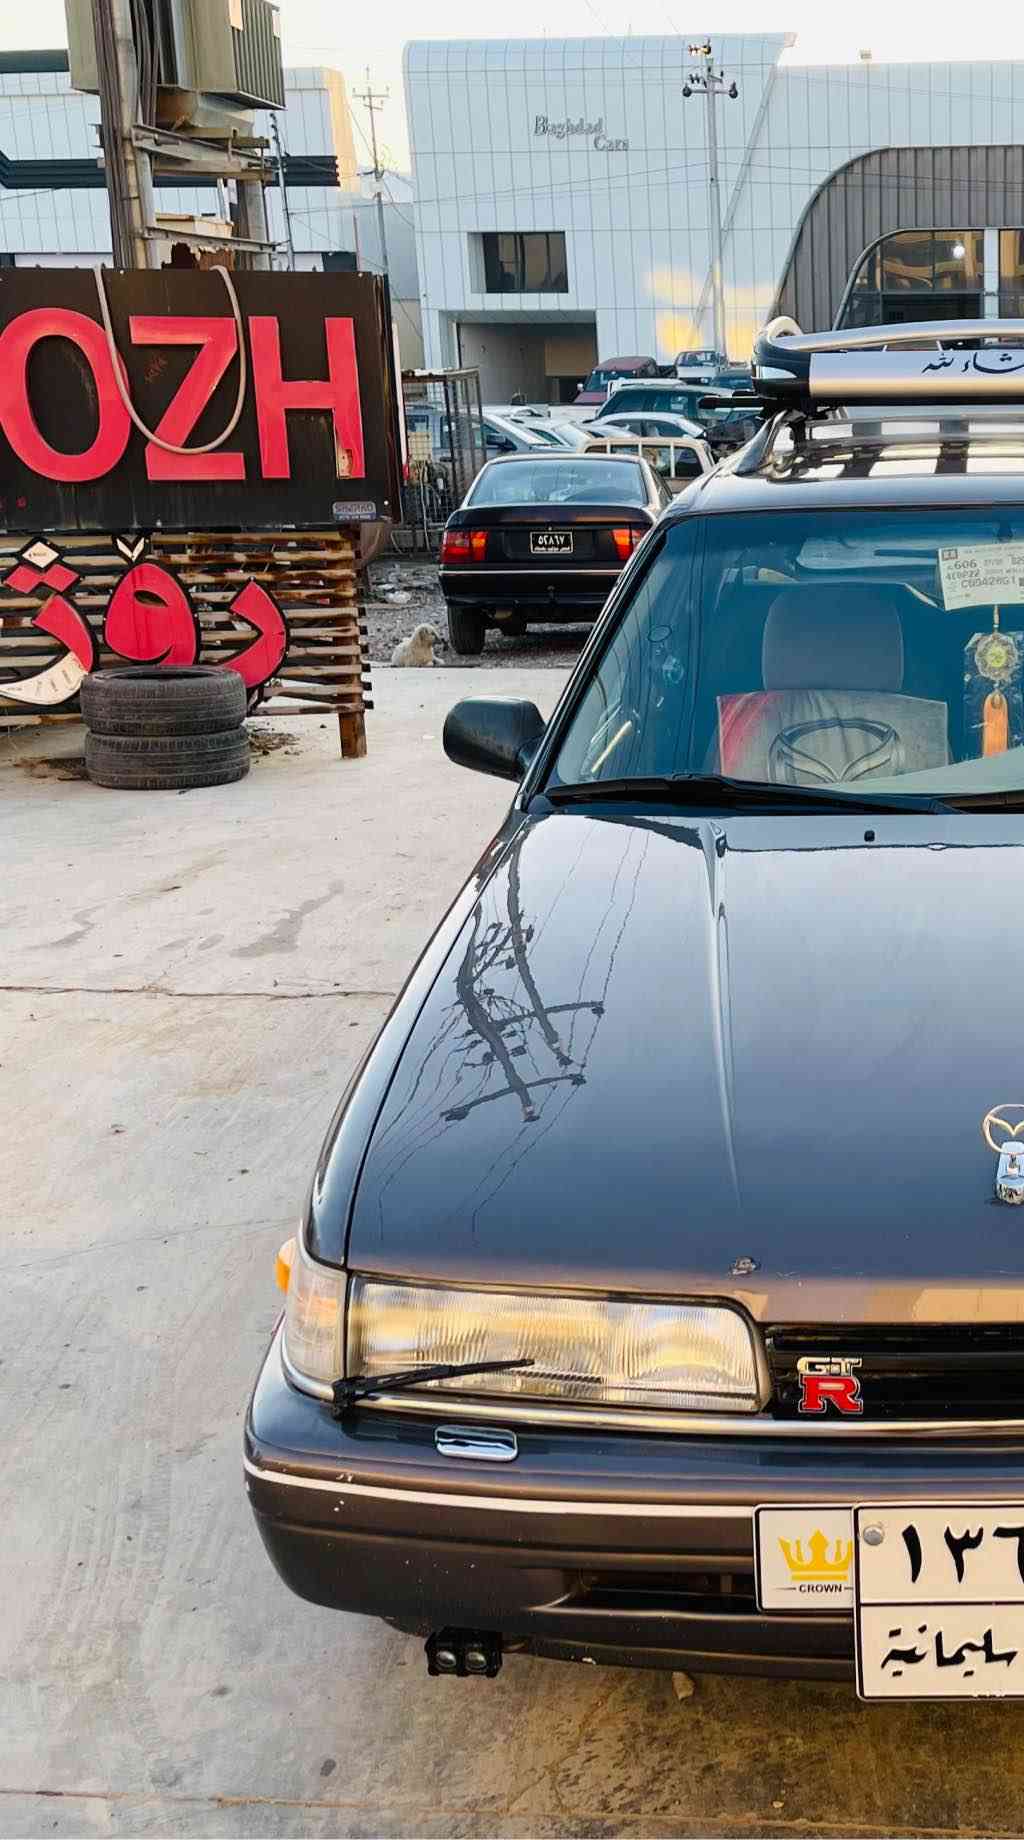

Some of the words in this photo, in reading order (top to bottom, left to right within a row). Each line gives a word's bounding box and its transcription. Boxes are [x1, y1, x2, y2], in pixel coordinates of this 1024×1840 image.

[533, 114, 605, 140] Baghdad
[799, 1583, 843, 1594] CROWN
[881, 1623, 1019, 1677] سليمانية
